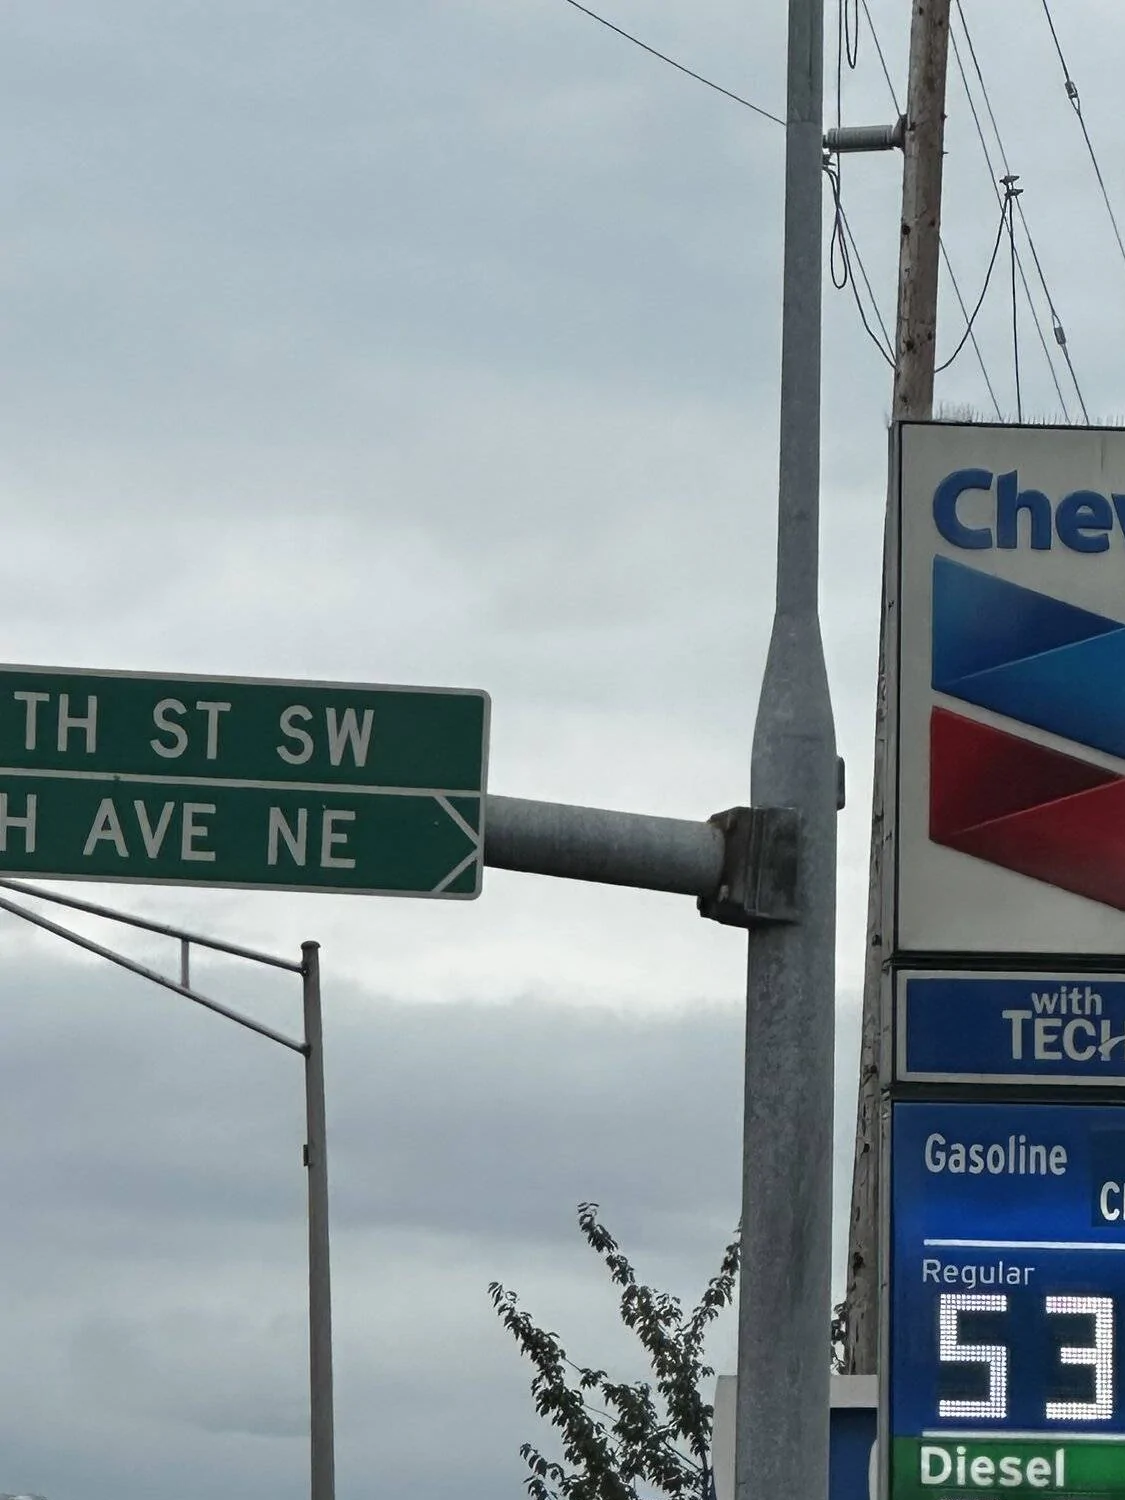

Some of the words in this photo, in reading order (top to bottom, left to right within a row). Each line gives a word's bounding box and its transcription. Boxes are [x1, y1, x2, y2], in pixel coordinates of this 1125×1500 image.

[13, 691, 98, 753] TH
[149, 698, 232, 760] ST
[276, 704, 375, 767] SW
[82, 798, 216, 862] AVE
[267, 806, 357, 869] NE
[1031, 986, 1103, 1016] with
[924, 1132, 1068, 1176] Gasoline
[922, 1258, 1036, 1290] Regular
[920, 1445, 1067, 1488] Diesel
